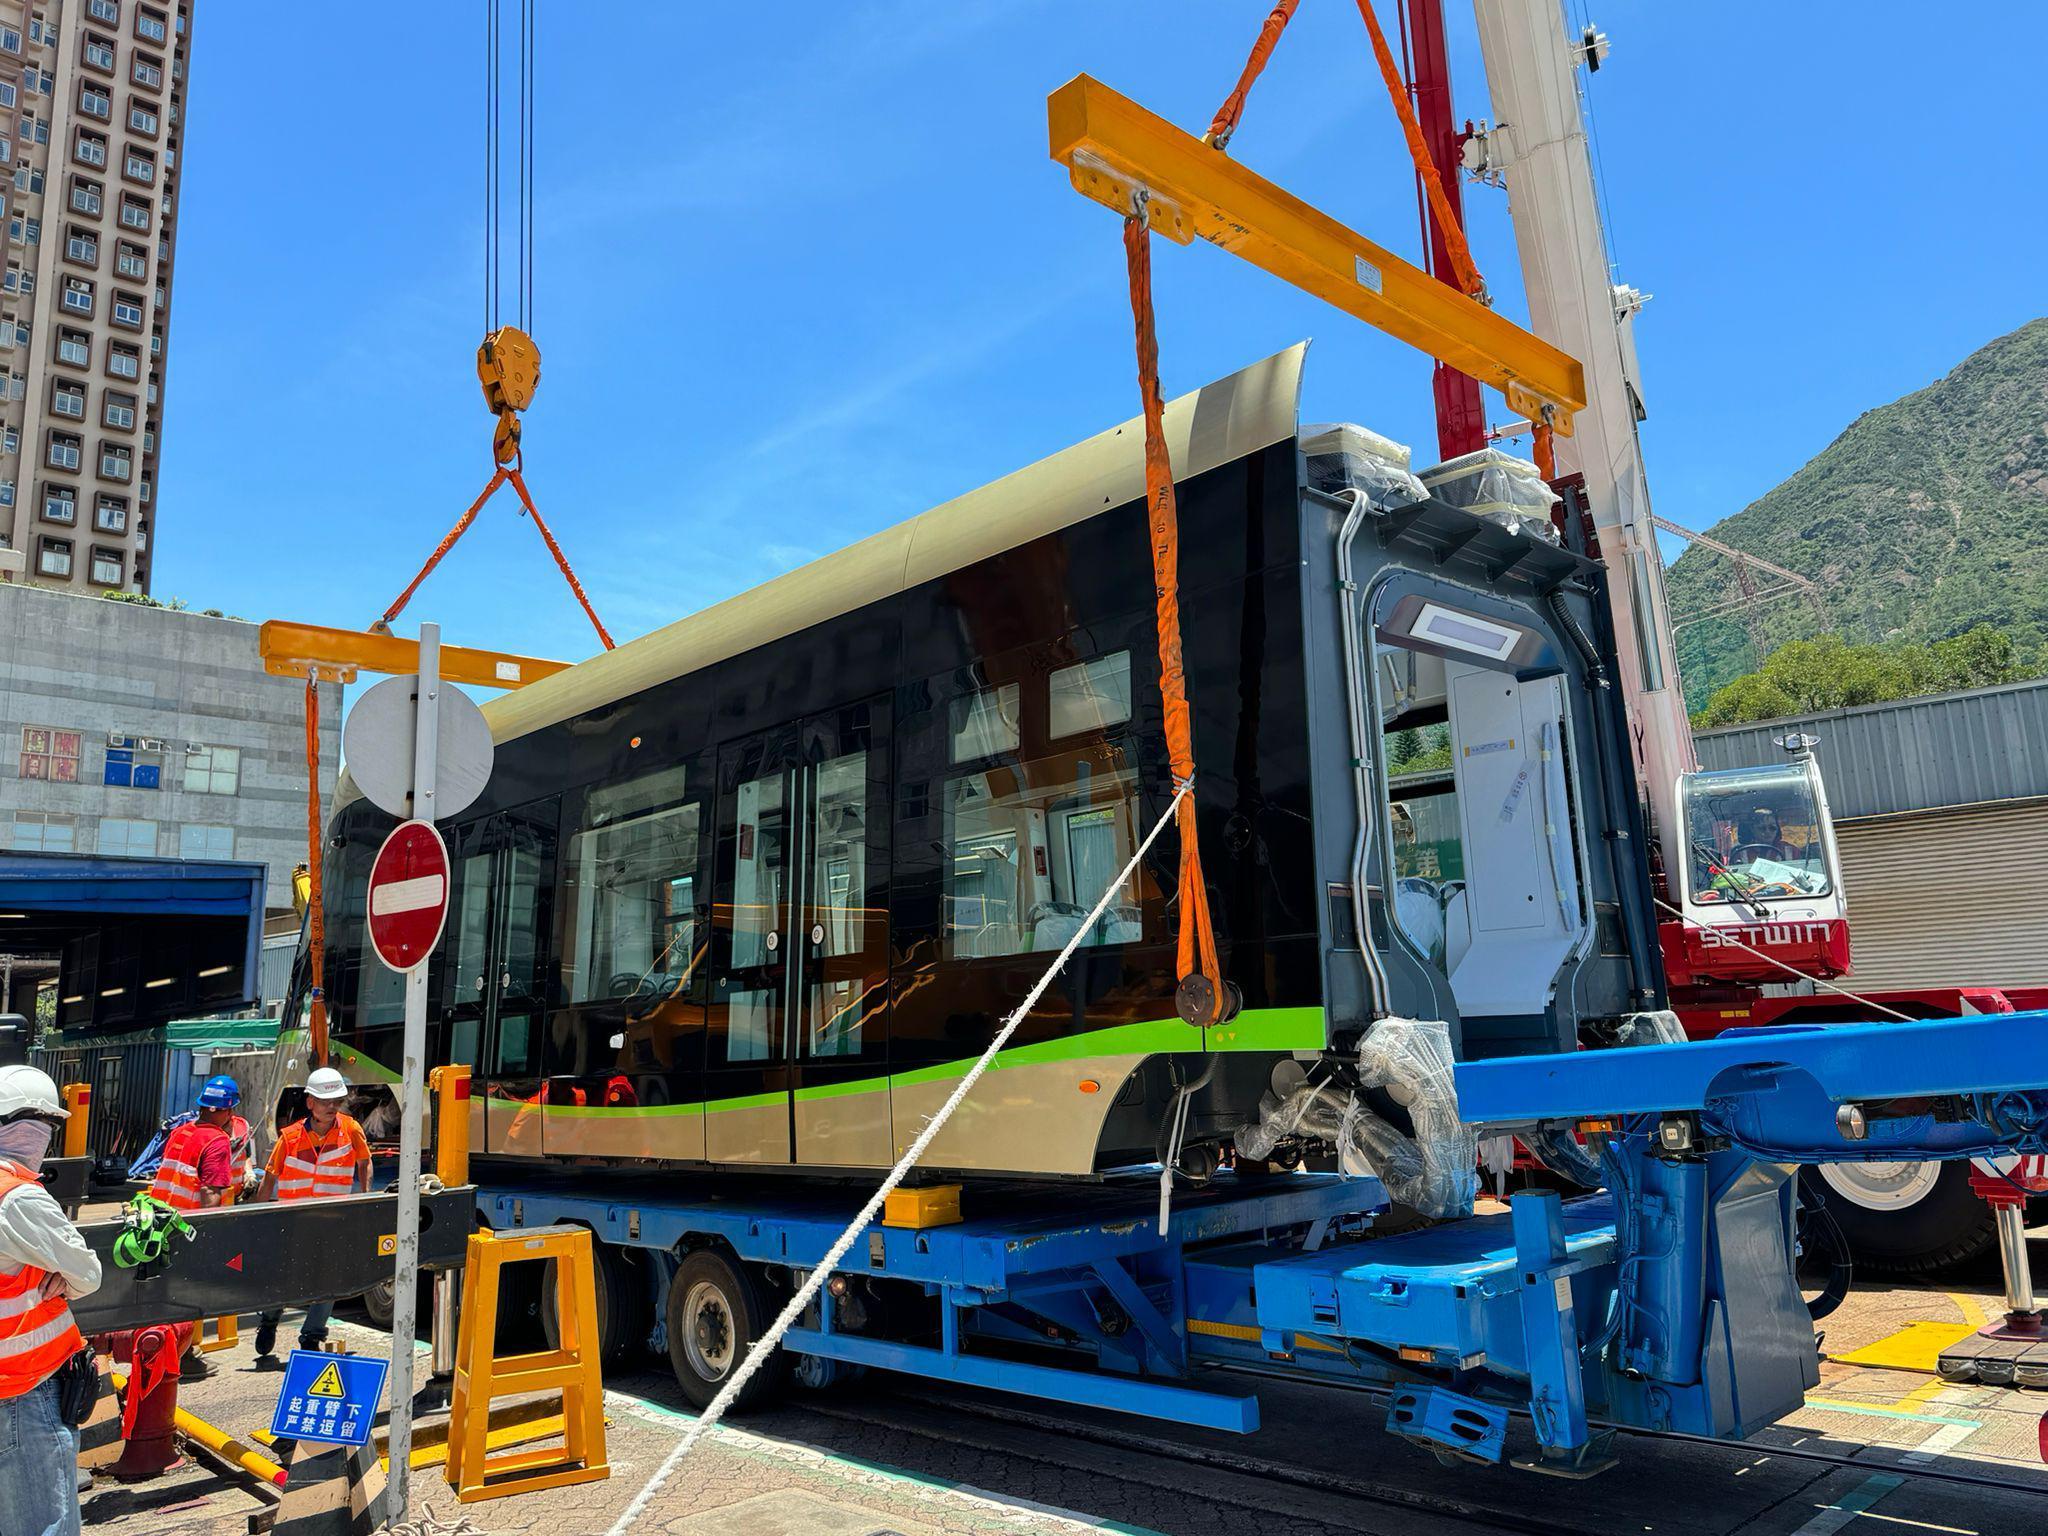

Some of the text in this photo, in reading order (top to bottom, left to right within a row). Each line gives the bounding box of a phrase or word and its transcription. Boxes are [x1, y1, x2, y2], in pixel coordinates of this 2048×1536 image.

[1157, 586, 1166, 598] M
[1699, 923, 1831, 948] SETWIN
[288, 1396, 362, 1419] 起重臂下
[284, 1414, 357, 1438] 严禁逗留
